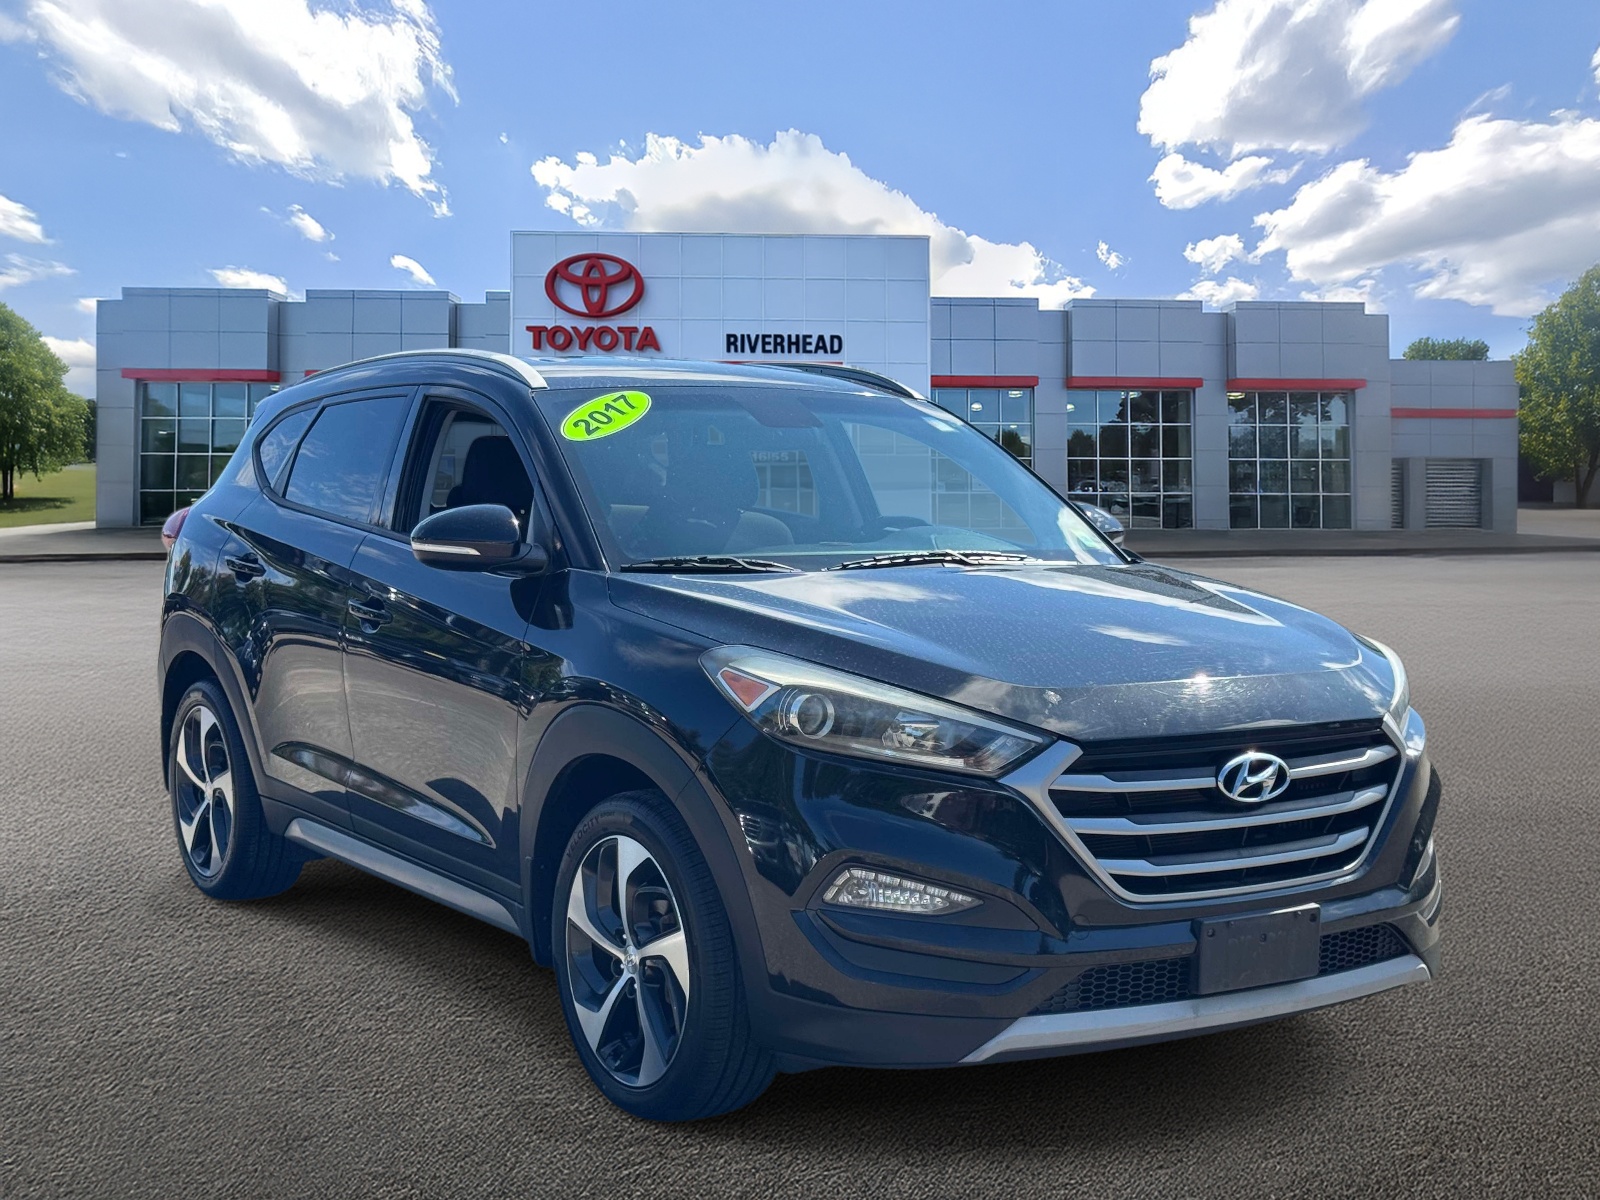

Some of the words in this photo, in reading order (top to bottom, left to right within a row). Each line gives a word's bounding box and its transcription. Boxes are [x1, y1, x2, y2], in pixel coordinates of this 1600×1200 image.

[525, 325, 661, 352] TOYOTA
[726, 333, 843, 354] RIVERHEAD
[572, 394, 636, 436] 2017
